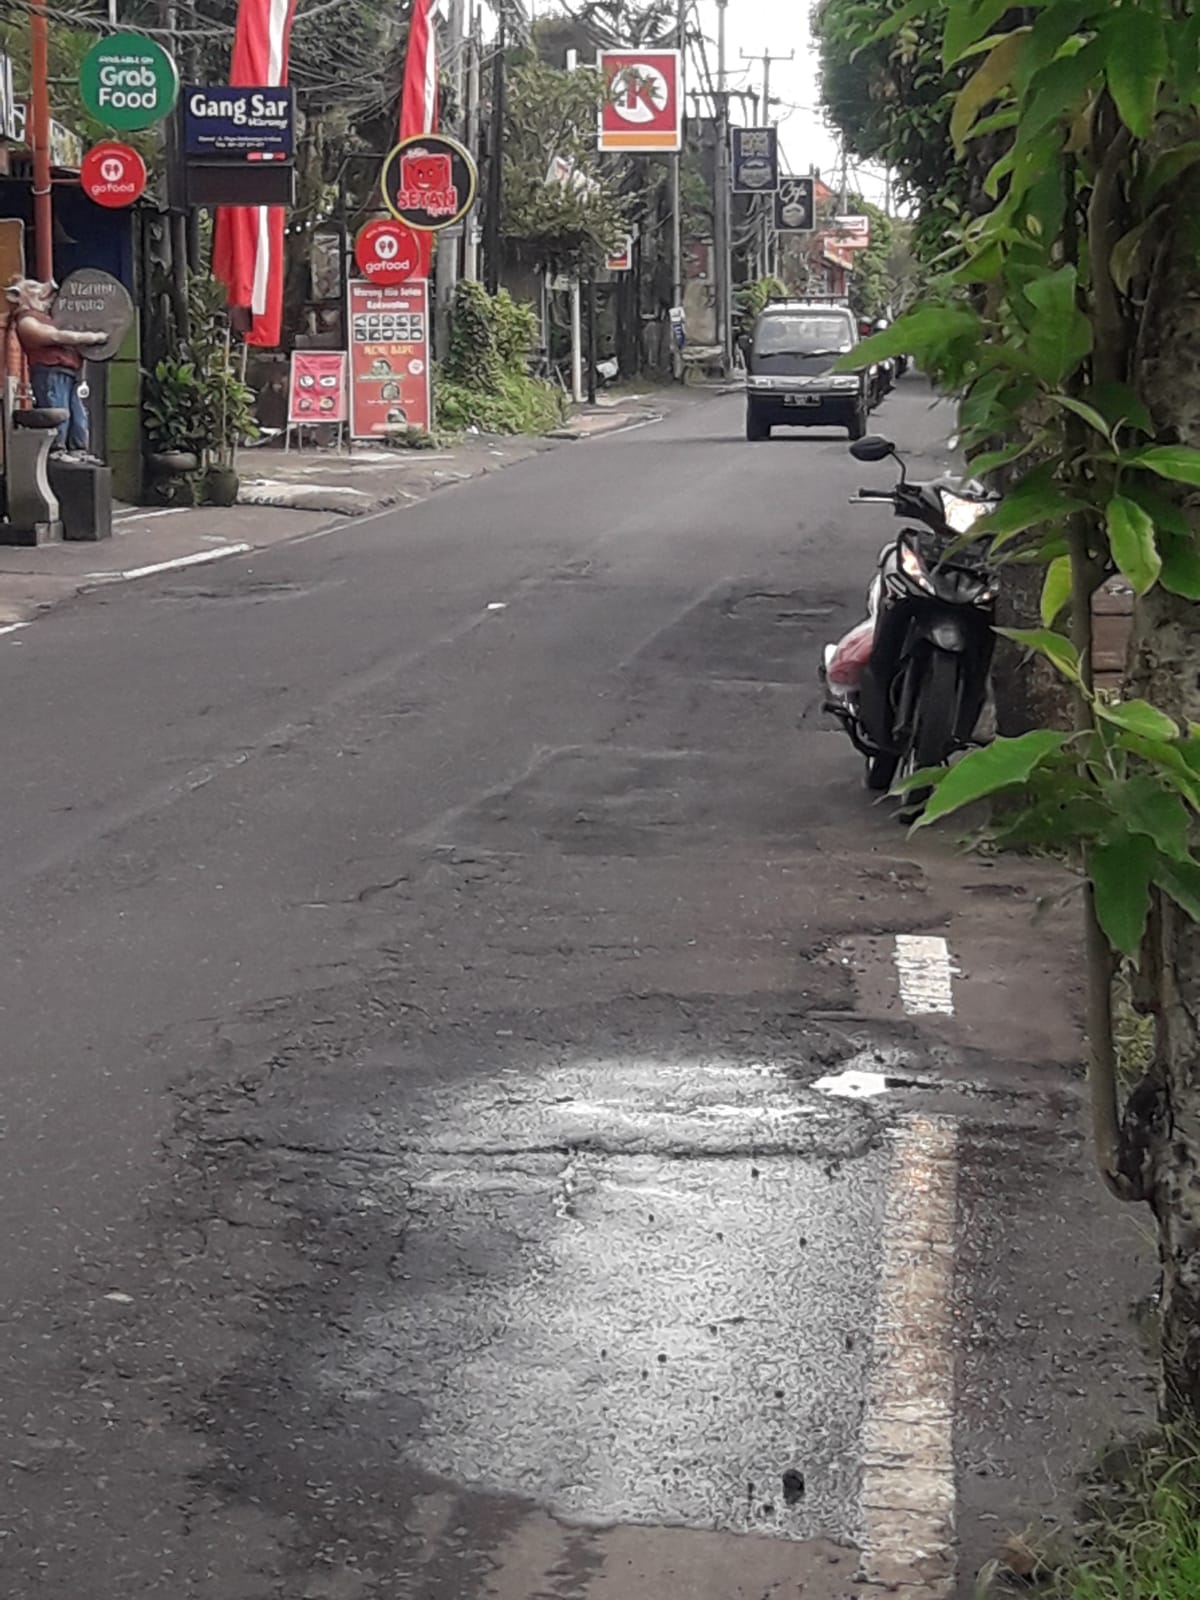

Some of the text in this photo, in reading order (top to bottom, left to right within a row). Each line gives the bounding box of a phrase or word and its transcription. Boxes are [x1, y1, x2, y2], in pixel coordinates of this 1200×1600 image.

[100, 65, 157, 87] Grab
[99, 87, 157, 109] Food
[190, 94, 288, 125] Gang Sar
[91, 182, 135, 196] gofood
[365, 259, 410, 274] gofood
